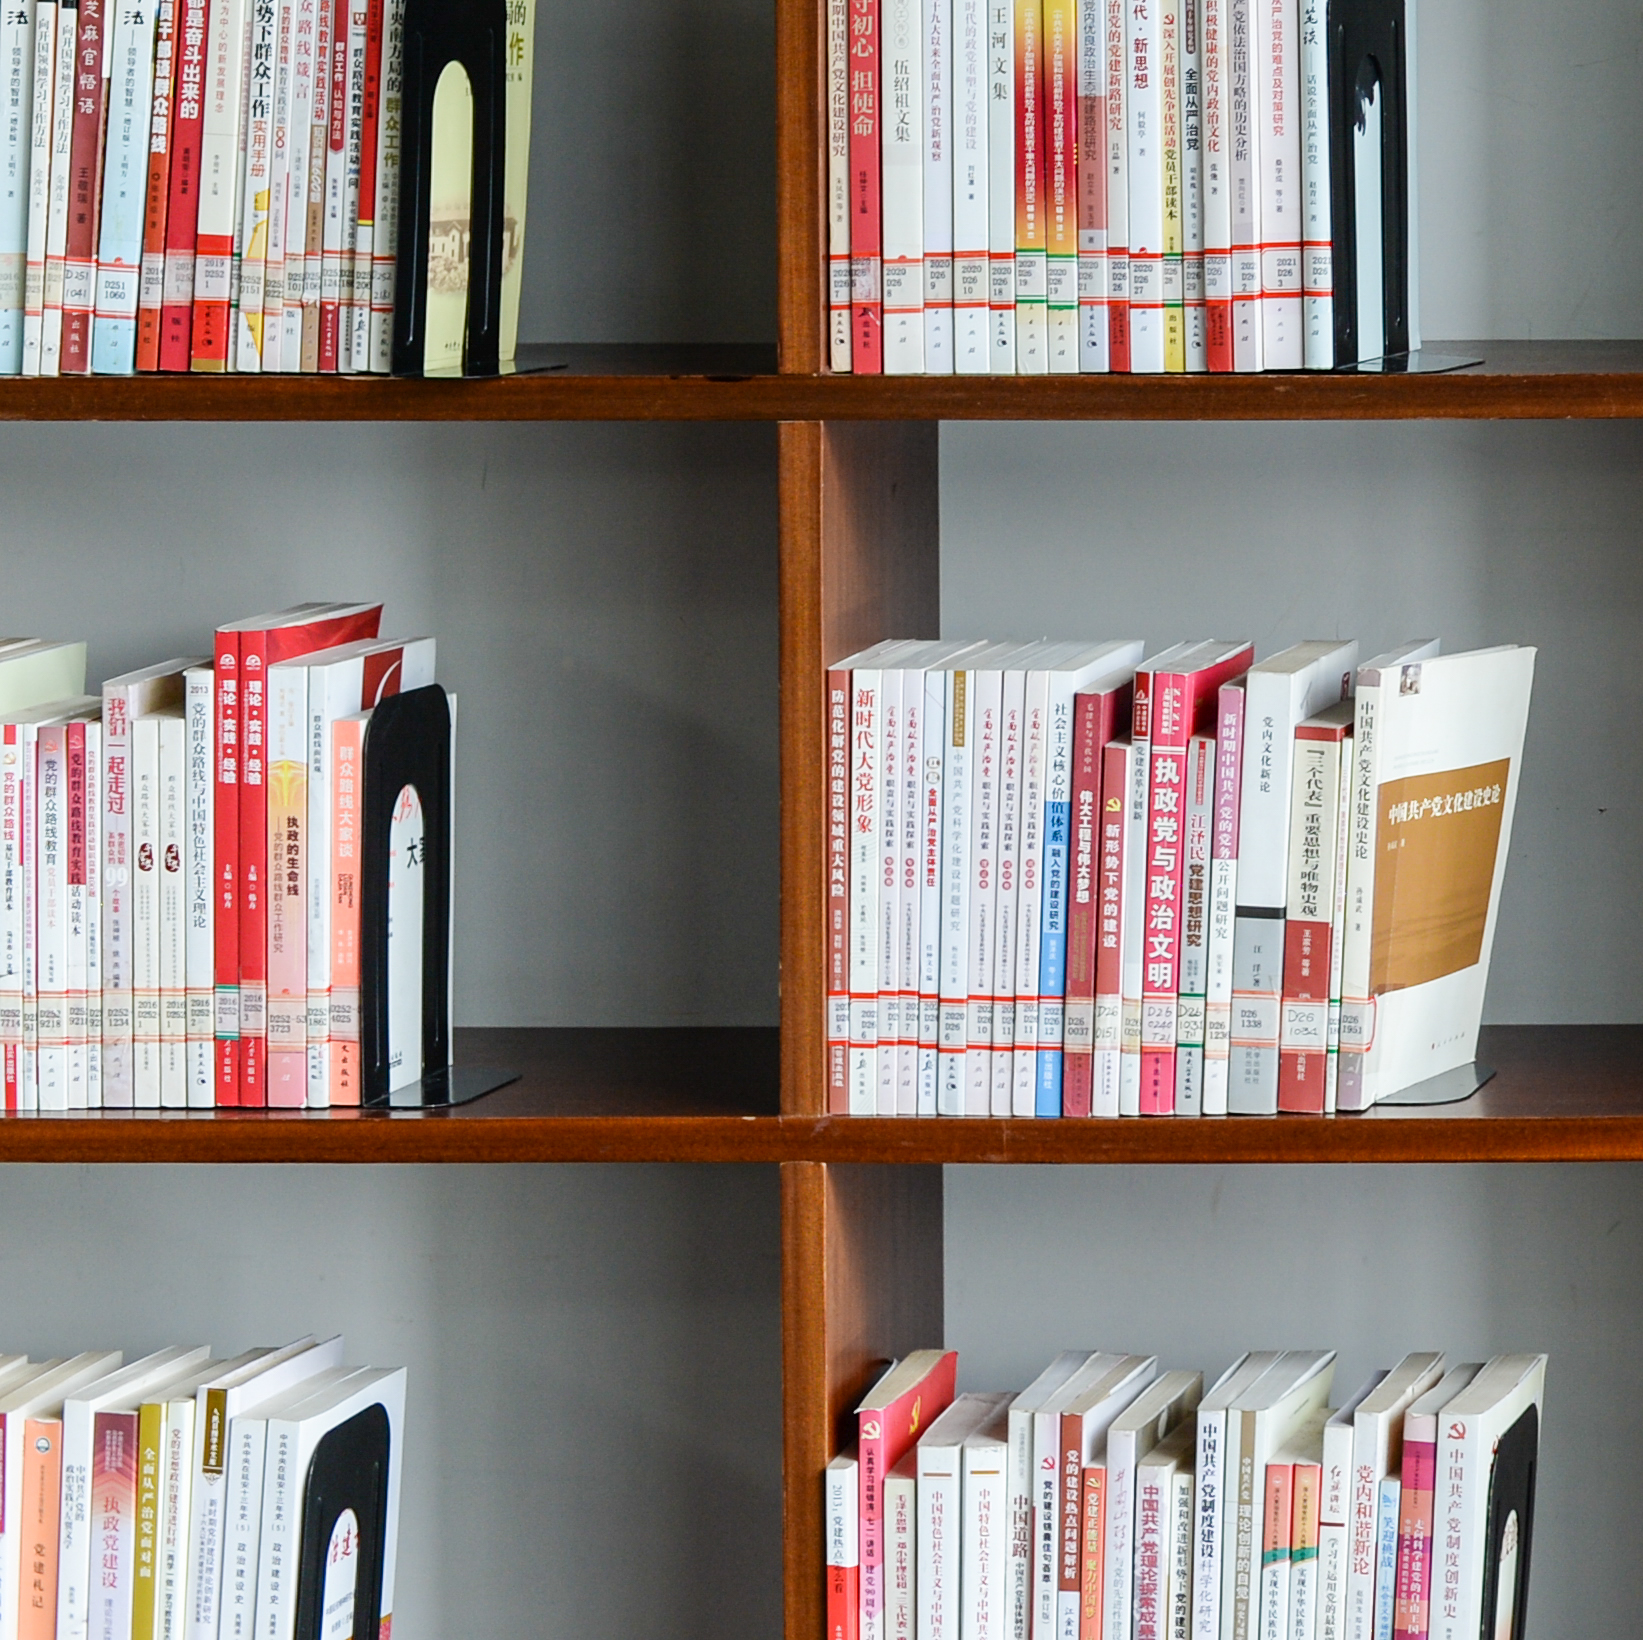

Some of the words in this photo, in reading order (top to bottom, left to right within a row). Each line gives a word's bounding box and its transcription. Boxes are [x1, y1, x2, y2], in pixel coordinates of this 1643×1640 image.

[851, 71, 873, 137] 担使命
[1355, 700, 1375, 860] 中国共产党文化建设史论
[1149, 759, 1178, 988] 执政党与政治文明
